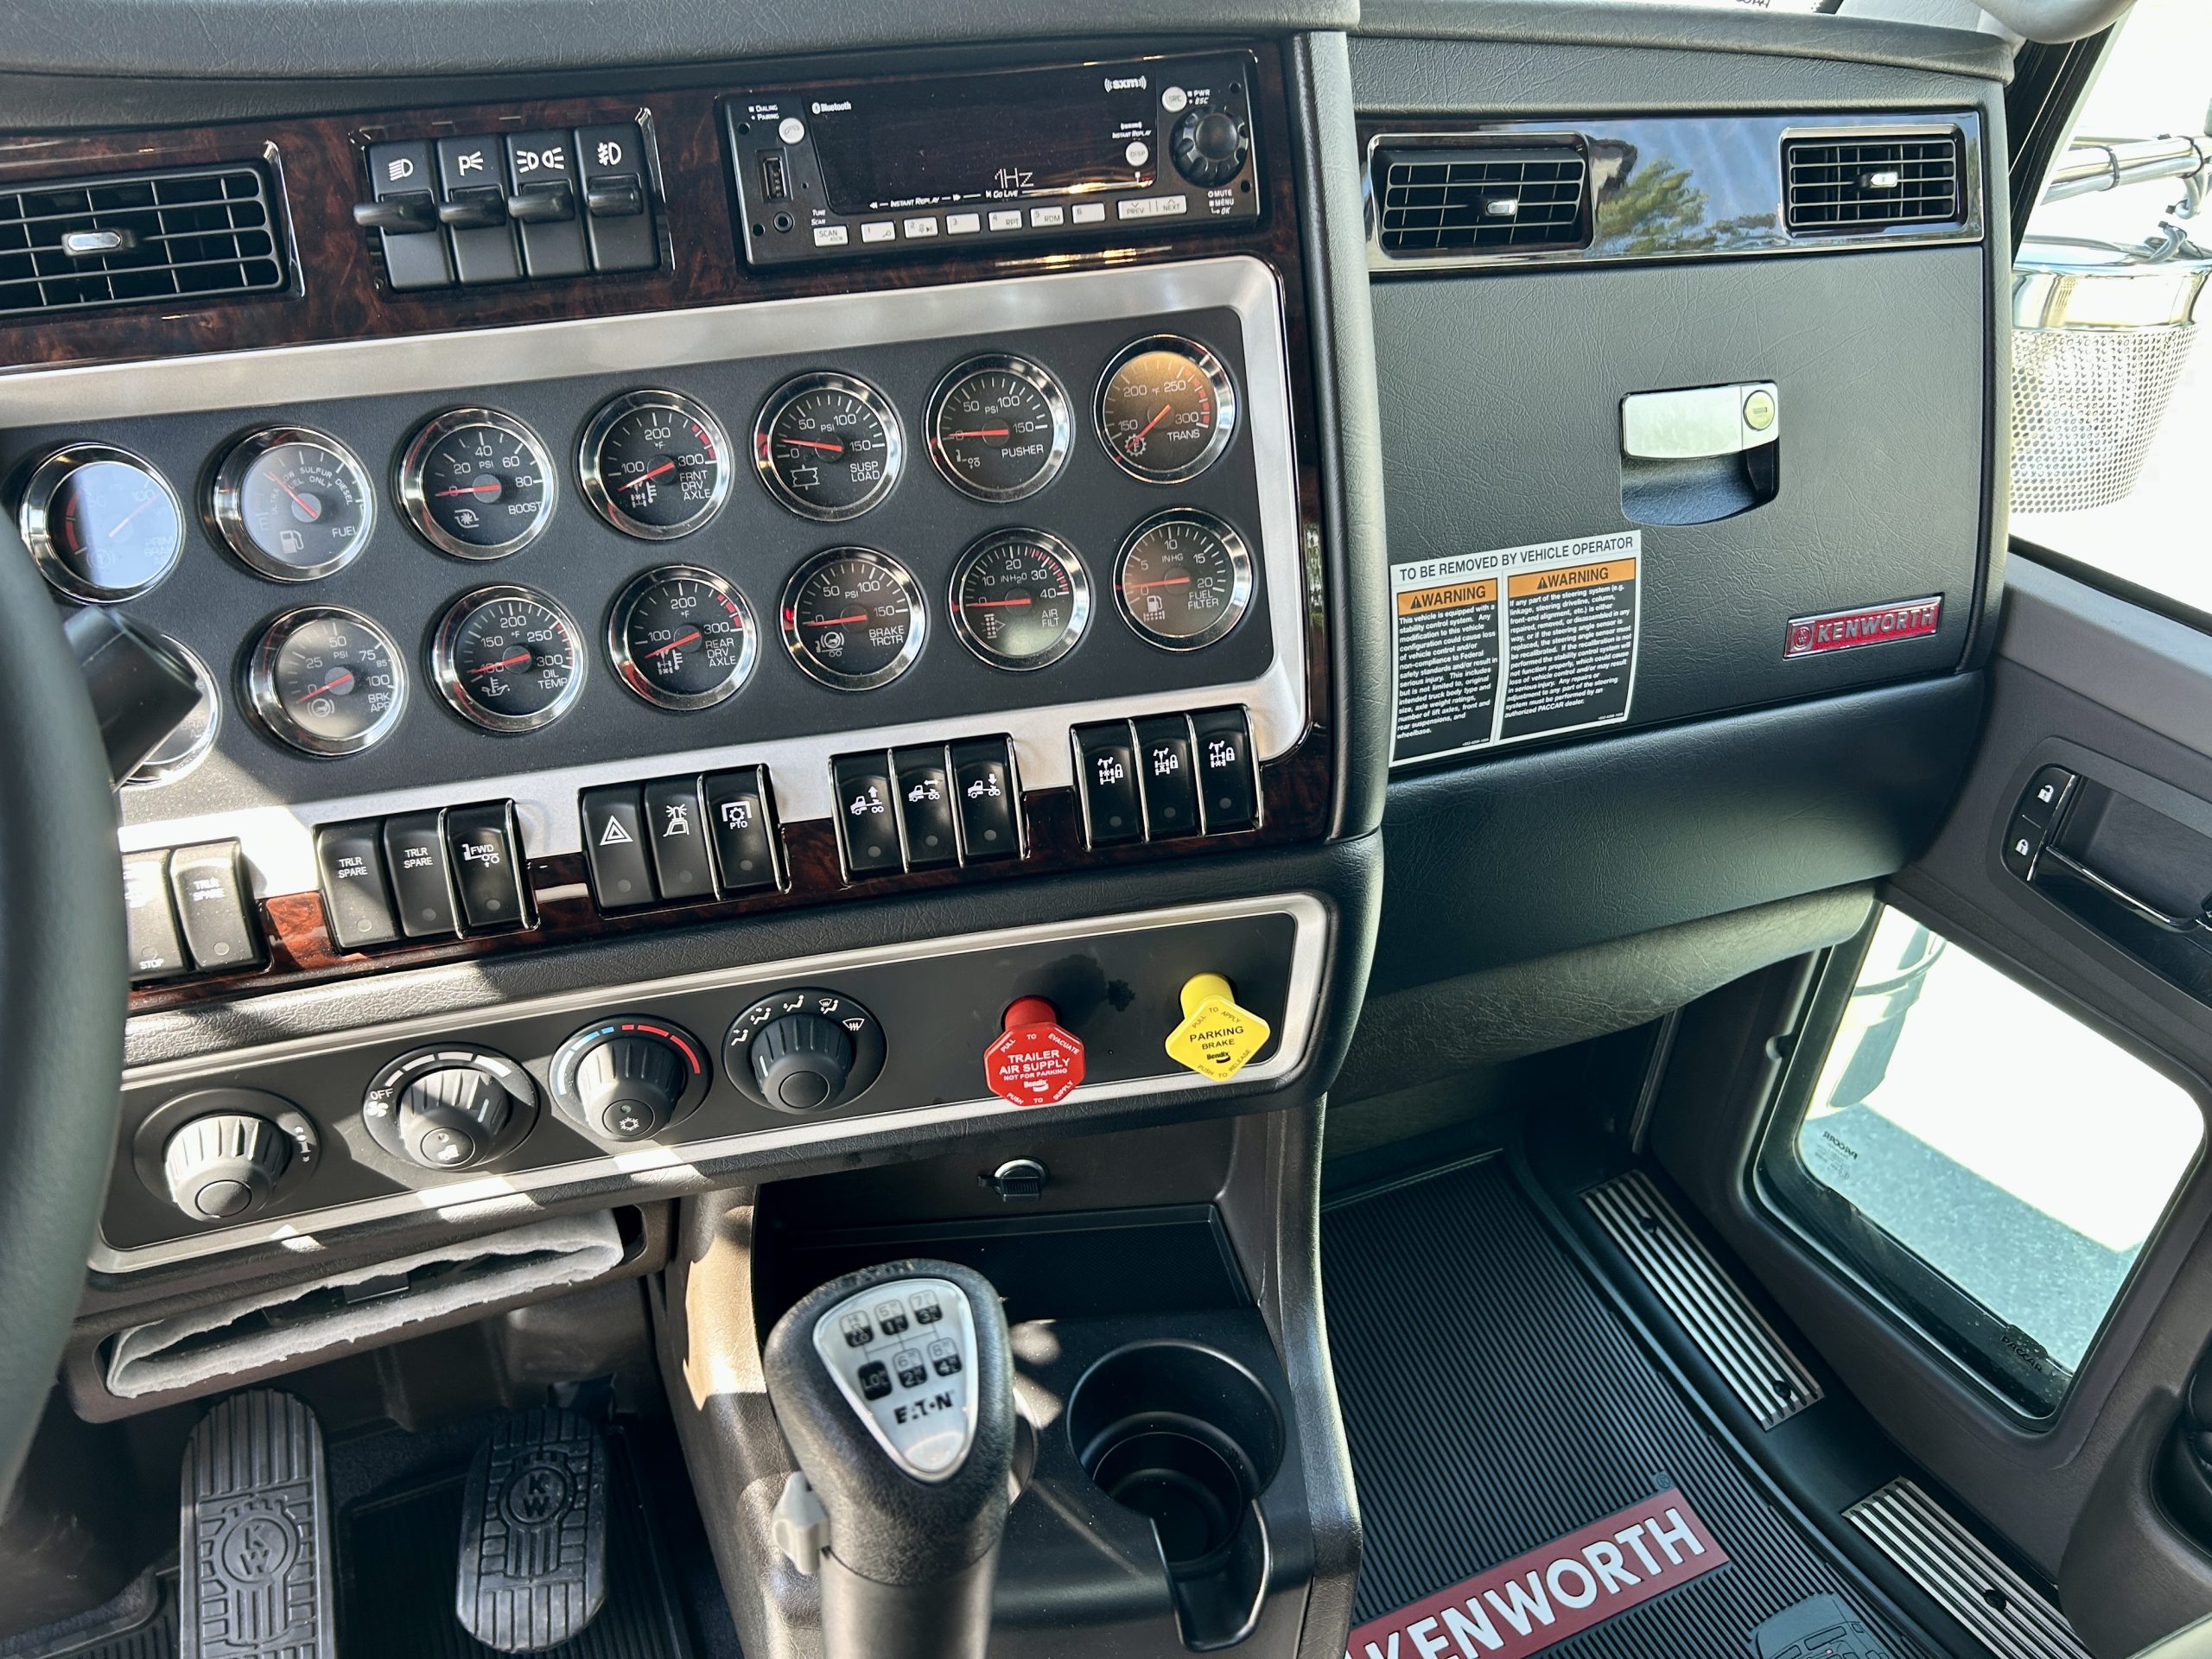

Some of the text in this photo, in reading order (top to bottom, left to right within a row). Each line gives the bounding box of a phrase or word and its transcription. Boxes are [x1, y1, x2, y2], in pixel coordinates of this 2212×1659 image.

[821, 101, 851, 111] Bluetooth
[1006, 218, 1019, 226] RPT
[1123, 380, 1186, 397] 200 250
[963, 400, 980, 412] 50
[997, 396, 1020, 407] 100
[985, 405, 999, 414] PSI
[834, 413, 857, 426] 100
[1175, 412, 1198, 423] 300
[798, 418, 816, 430] 50
[1013, 422, 1034, 433] 150
[1118, 420, 1138, 431] 150
[645, 427, 671, 439] 200
[1166, 429, 1200, 442] TRANS
[475, 445, 493, 457] 40
[849, 441, 871, 452] 150
[1001, 444, 1044, 457] PUSHER
[479, 460, 494, 469] PSI
[502, 455, 520, 467] 60
[677, 454, 704, 466] 300
[454, 462, 471, 474] 20
[621, 461, 645, 473] 100
[849, 461, 879, 473] SUSP
[515, 475, 532, 487] 80
[680, 470, 708, 481] FRNT
[851, 470, 880, 482] LOAD
[300, 467, 353, 505] SULFUR DIESEL
[309, 476, 332, 488] ONLY
[681, 480, 703, 492] DRV
[683, 489, 711, 500] AXLE
[508, 501, 542, 515] BOOST
[332, 525, 358, 537] FUEL
[1164, 539, 1177, 550] 10
[1005, 559, 1021, 570] 20
[1192, 553, 1205, 564] 15
[1400, 536, 1633, 581] TO BE REMOVED BY VEHICLE OPERATOR
[1032, 569, 1047, 580] 30
[1548, 567, 1609, 587] WARNING
[857, 581, 880, 593] 100
[1197, 577, 1212, 588] 20
[1040, 588, 1057, 598] 40
[1189, 590, 1213, 601] FUEL
[1421, 586, 1485, 607] WARNING
[1516, 600, 1527, 608] any
[1529, 597, 1541, 606] part
[1562, 589, 1586, 600] steering
[1589, 586, 1611, 594] system
[671, 597, 696, 609] 200
[1187, 597, 1219, 609] FILTER
[873, 605, 895, 617] 150
[1042, 608, 1058, 619] AIR
[1414, 613, 1436, 621] vehicle
[1445, 607, 1474, 617] equipped
[1476, 604, 1490, 613] with
[500, 615, 526, 628] 200
[1042, 617, 1059, 628] FILT
[1399, 624, 1424, 633] stability
[1426, 620, 1448, 629] control
[1449, 617, 1474, 626] system.
[1817, 607, 1934, 643] KENWORTH
[703, 622, 729, 634] 300
[869, 626, 905, 638] BRAKE
[1399, 631, 1439, 643] modification
[1449, 626, 1460, 635] this
[1462, 624, 1484, 632] vehicle
[329, 636, 346, 647] 50
[480, 635, 503, 647] 150
[527, 629, 552, 642] 250
[870, 634, 904, 645] TRCTR
[706, 639, 734, 650] REAR
[1400, 640, 1442, 652] configuration
[1443, 635, 1461, 645] could
[1462, 633, 1481, 642] cause
[334, 651, 348, 659] PSI
[359, 650, 376, 661] 75
[707, 649, 729, 659] DRV
[306, 657, 322, 669] 25
[537, 654, 563, 667] 300
[709, 656, 736, 667] AXLE
[366, 674, 390, 686] 100
[543, 670, 559, 679] OIL
[537, 677, 568, 690] TEMP
[368, 693, 390, 703] BRK
[1504, 708, 1536, 718] authorized
[1538, 702, 1564, 712] PACCAR
[729, 821, 747, 830] PTO
[404, 848, 428, 858] TRLR
[471, 843, 494, 855] FWD
[339, 857, 362, 868] TRLR
[404, 856, 433, 868] SPARE
[338, 866, 367, 879] SPARE
[139, 958, 164, 969] STOP
[1192, 1014, 1206, 1028] PULL
[1221, 1011, 1241, 1024] APPLY
[1190, 1026, 1244, 1042] PARKING
[1001, 1038, 1016, 1052] PULL
[1048, 1033, 1079, 1054] EVACUATE
[1202, 1038, 1236, 1050] BRAKE
[1007, 1050, 1060, 1063] TRAILER
[1197, 1064, 1214, 1076] PUSH
[1229, 1048, 1252, 1072] RELEASE
[999, 1058, 1071, 1074] AIR SUPPLY
[1036, 1068, 1068, 1077] PARKING
[370, 1089, 393, 1100] OFF
[1006, 1092, 1024, 1104] PUSH
[1052, 1080, 1074, 1101] SUPPLY
[2000, 1335, 2042, 1372] PACCAR
